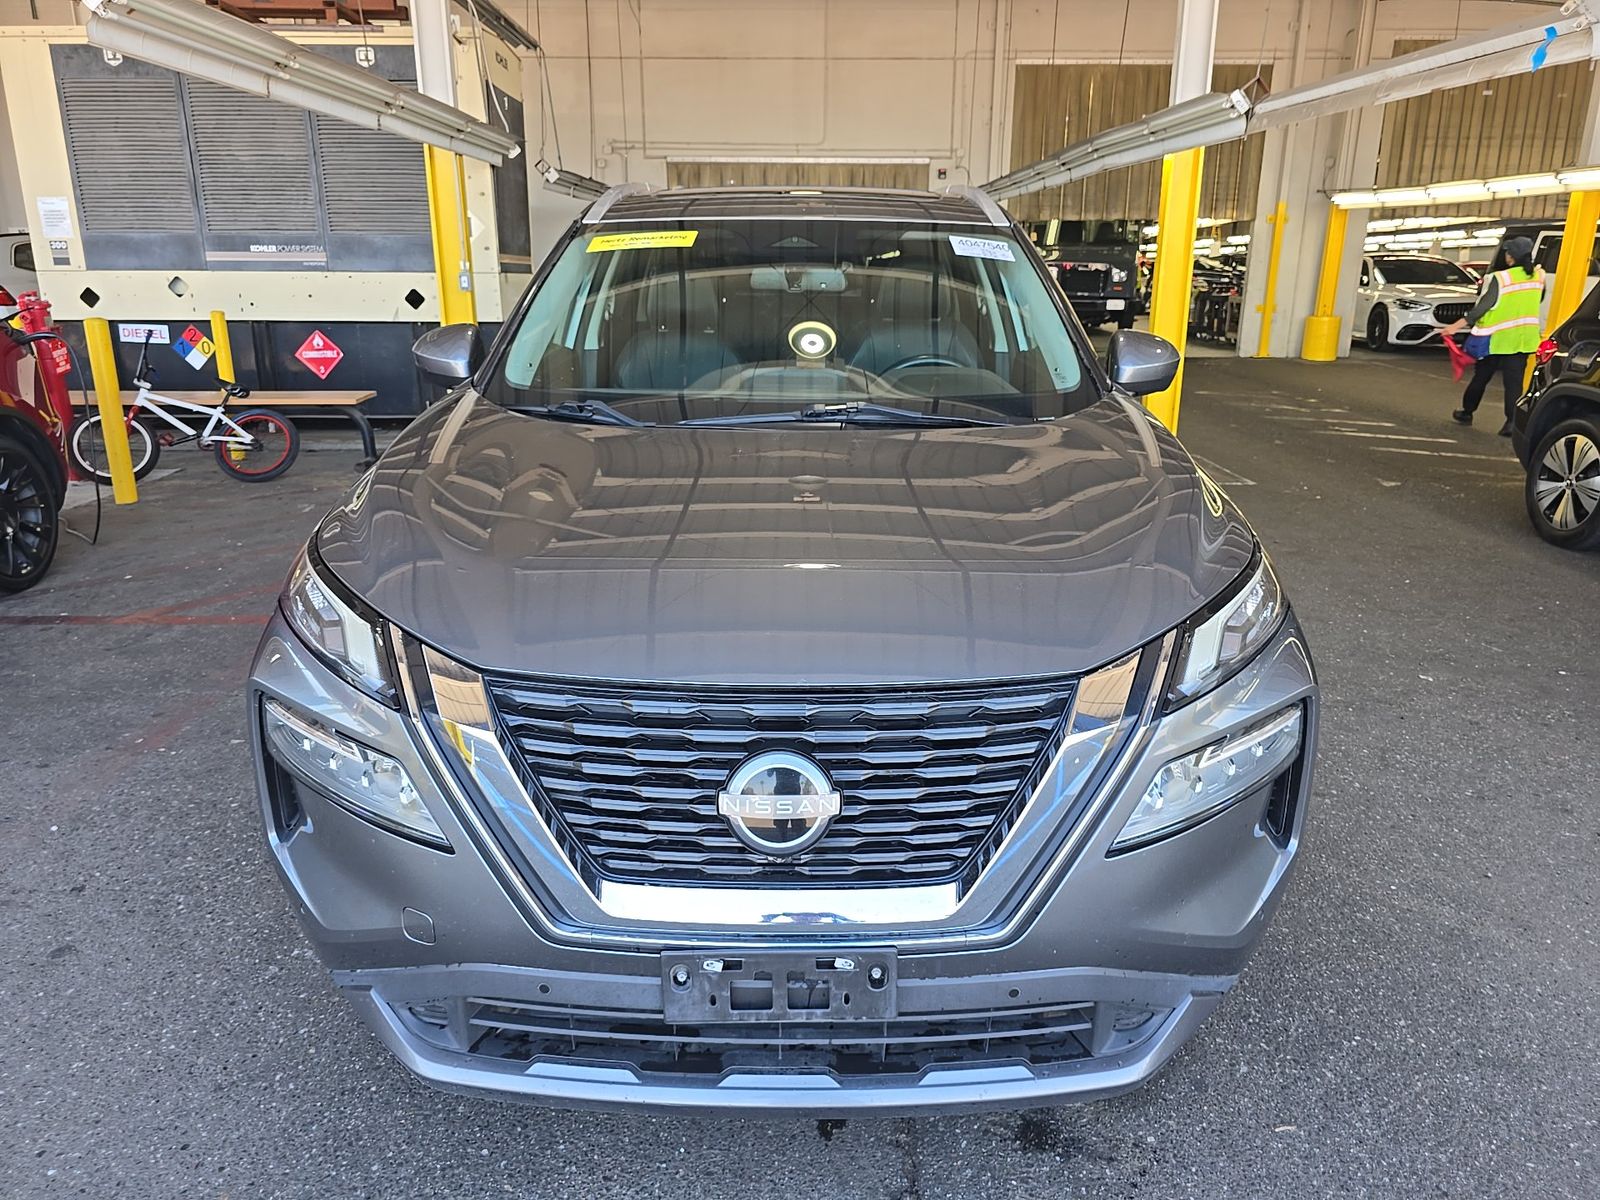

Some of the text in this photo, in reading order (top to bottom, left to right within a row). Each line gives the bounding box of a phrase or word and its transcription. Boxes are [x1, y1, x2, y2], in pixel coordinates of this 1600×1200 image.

[50, 241, 67, 249] 300
[277, 245, 301, 253] POWER
[188, 328, 198, 342] 2
[201, 340, 211, 355] 0
[722, 799, 836, 815] NISSAN
